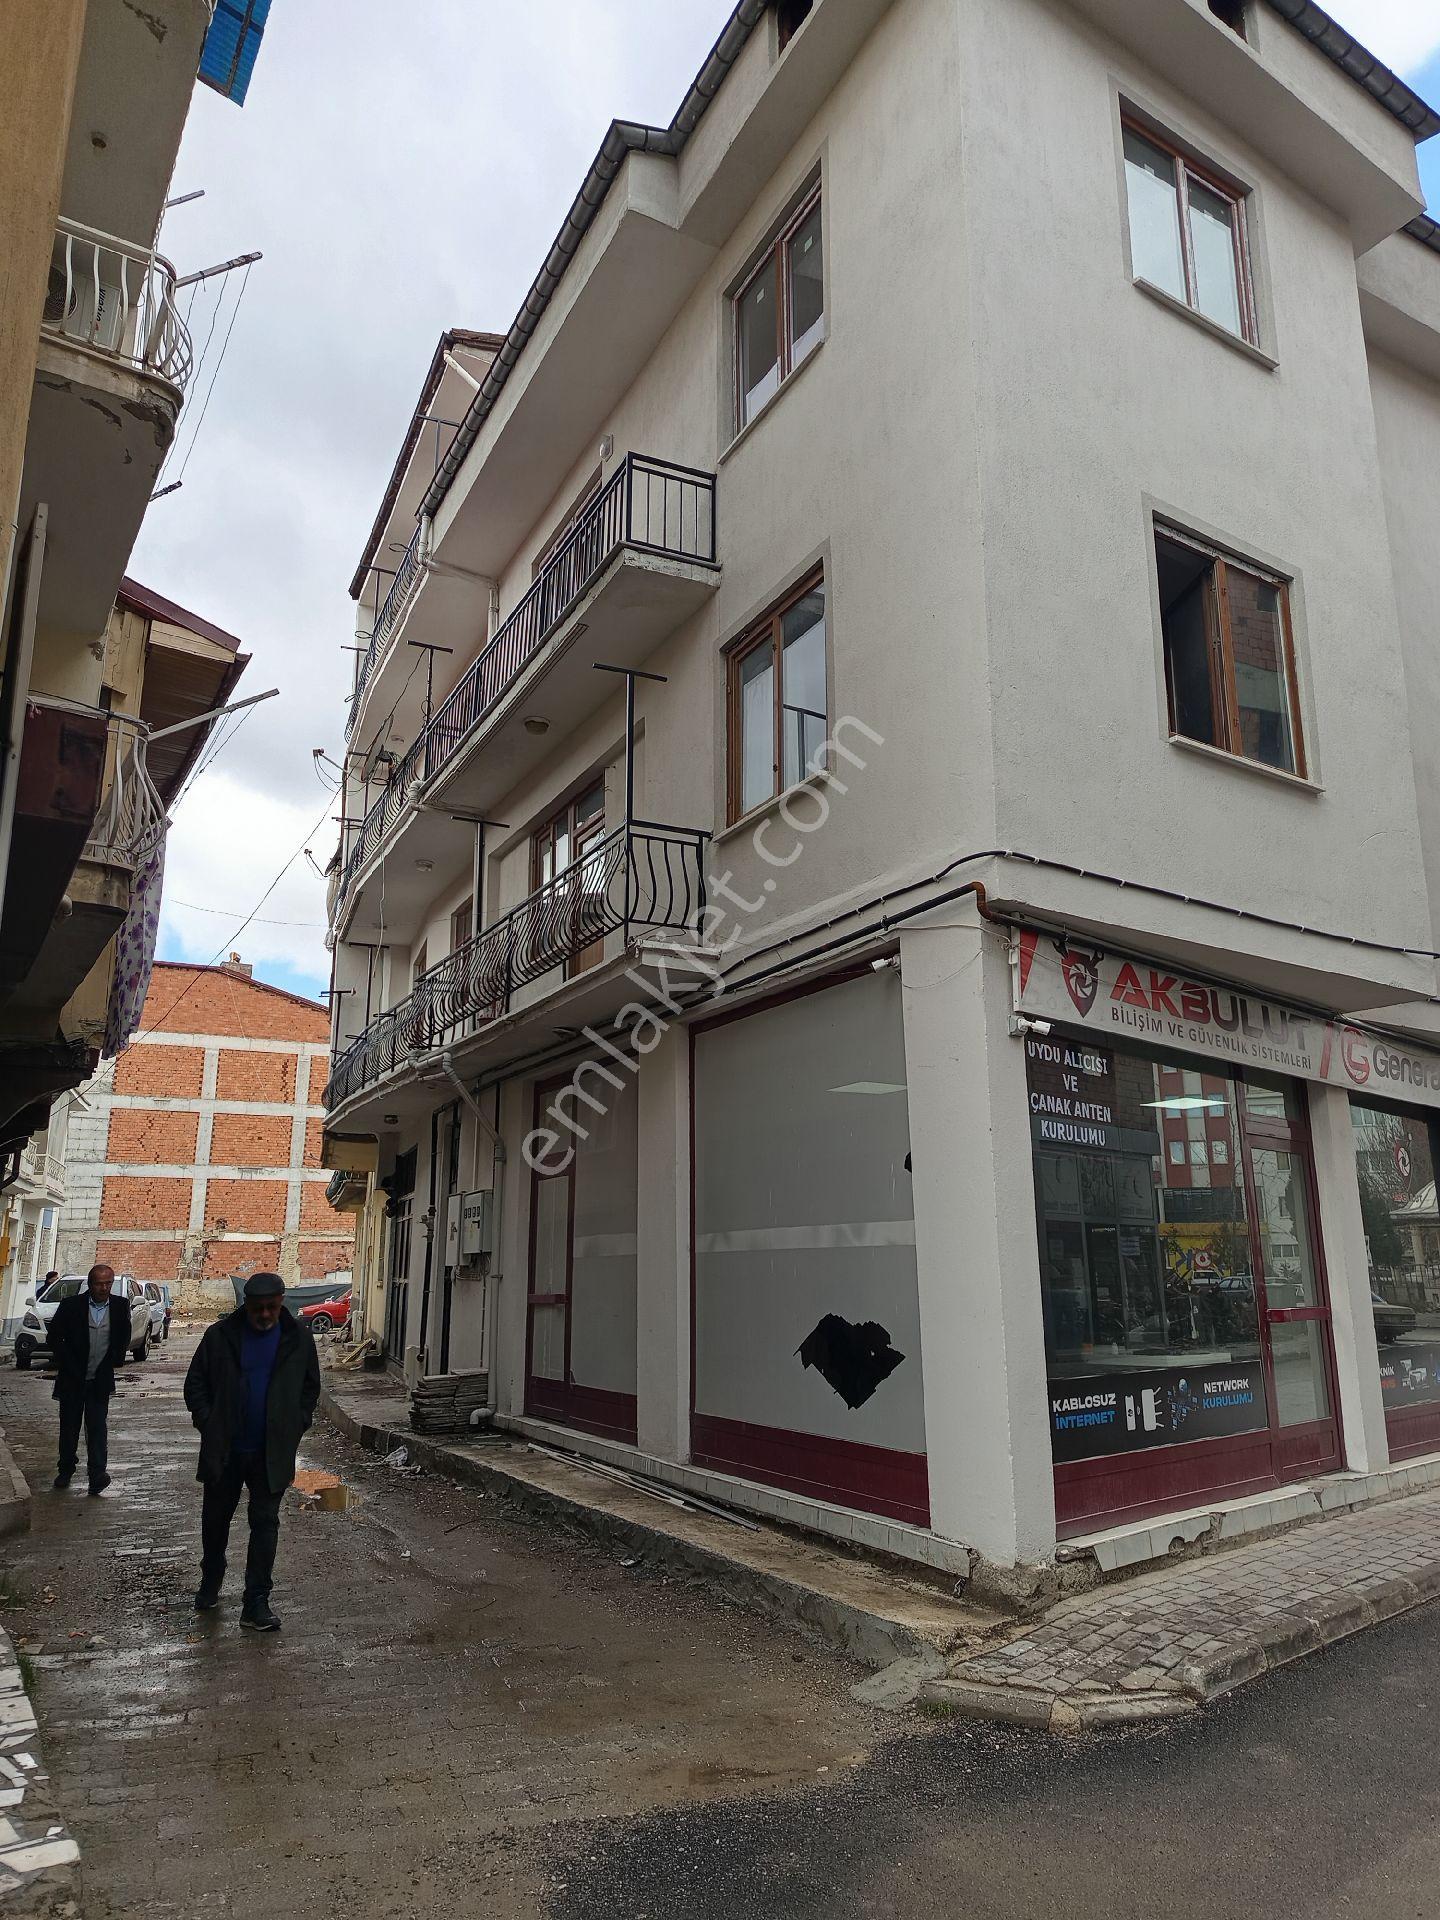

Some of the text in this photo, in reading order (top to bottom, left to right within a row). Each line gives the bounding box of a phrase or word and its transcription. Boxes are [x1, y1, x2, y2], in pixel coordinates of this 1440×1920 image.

[1109, 962, 1311, 1051] AKBULUT
[1111, 1006, 1312, 1070] BİLİŞİM VE GÜVENLİK SİSTEMLERİ
[1028, 1040, 1108, 1075] UYDU ALICISI
[1062, 1073, 1079, 1093] VE
[1030, 1092, 1112, 1123] ÇANAK ANTEN
[1040, 1119, 1106, 1147] KURULUMU
[1203, 1378, 1250, 1394] NETWORK
[1052, 1393, 1117, 1413] KABLOSUZ
[1202, 1392, 1253, 1409] KURULUMU
[1055, 1411, 1116, 1430] İNTERNET
